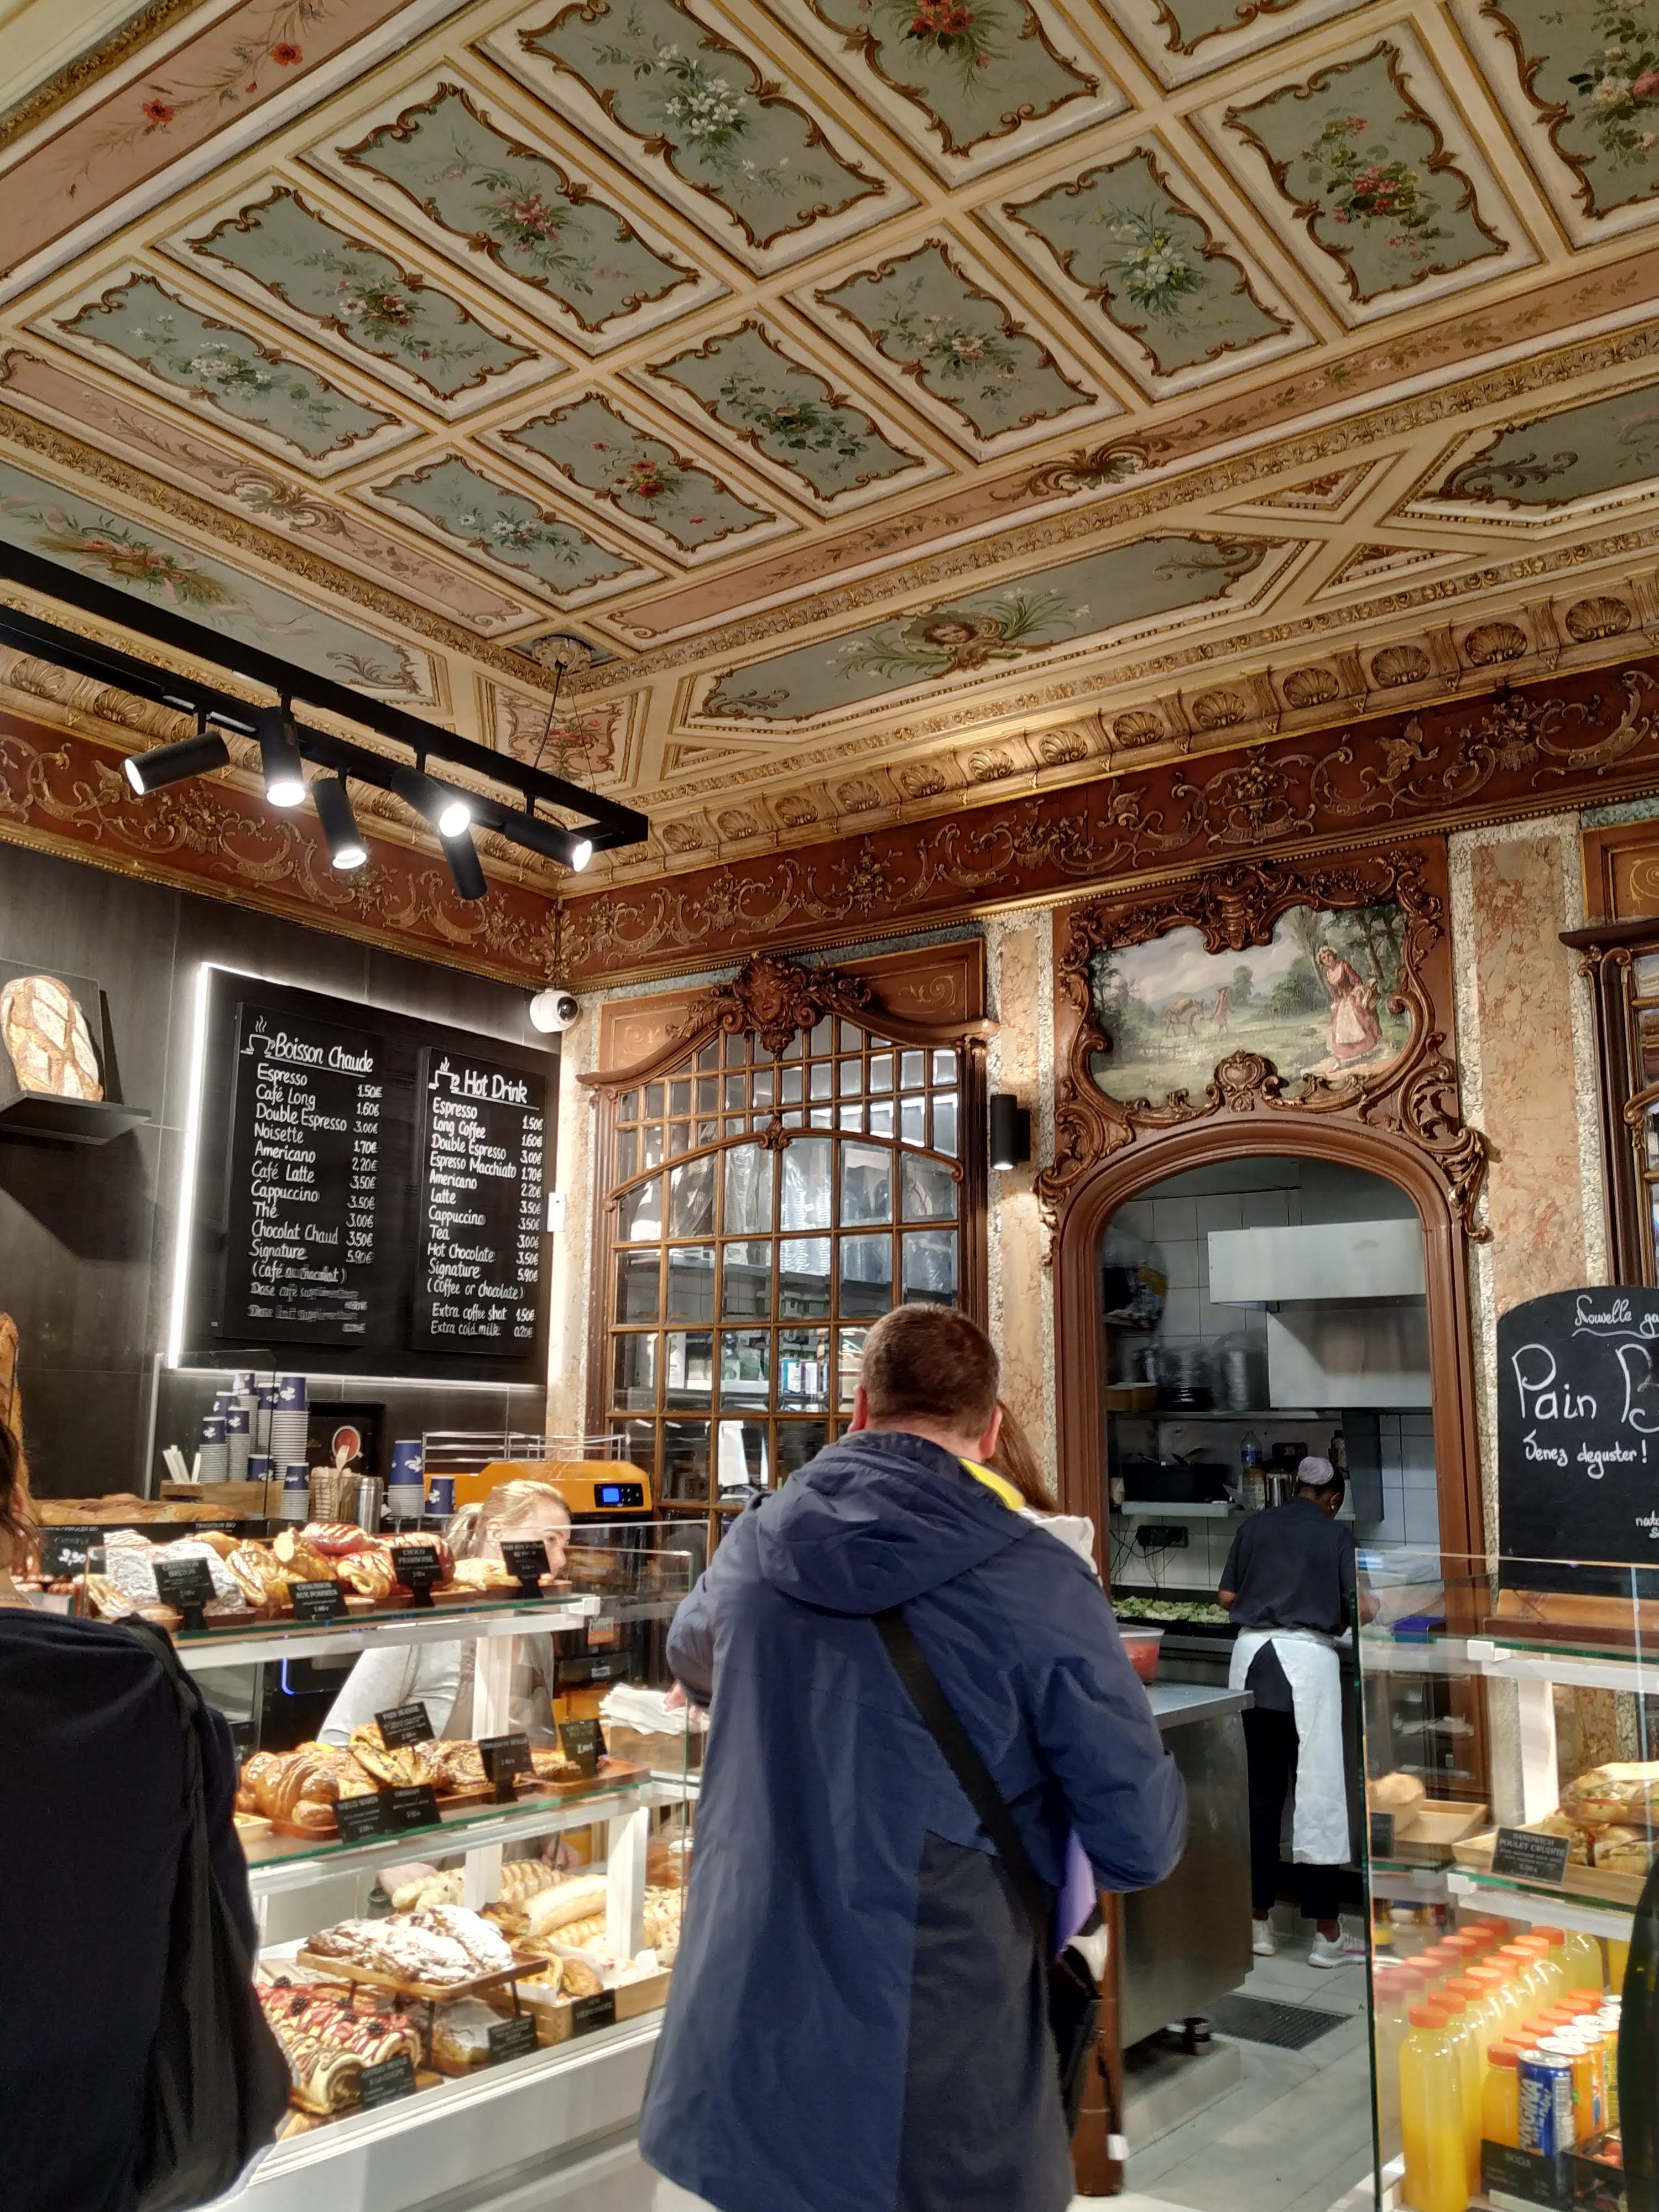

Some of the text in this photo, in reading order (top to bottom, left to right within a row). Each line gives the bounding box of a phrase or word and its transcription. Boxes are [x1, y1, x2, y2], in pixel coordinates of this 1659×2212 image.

[275, 1032, 373, 1072] Boisson Chaude
[257, 1063, 307, 1086] Espresso
[256, 1084, 284, 1105] Café
[288, 1087, 315, 1111] Long
[464, 1070, 528, 1104] Hot Drink
[256, 1103, 299, 1125] Double
[301, 1108, 347, 1131] Espresso
[432, 1097, 477, 1119] Espresso
[254, 1122, 304, 1144] Noisette
[433, 1116, 455, 1136] Long
[458, 1120, 486, 1139] Coffee
[254, 1140, 316, 1163] Americano
[431, 1133, 466, 1154] Double
[468, 1139, 507, 1161] Espresso
[251, 1161, 279, 1182] Café
[286, 1164, 315, 1183] Latte
[430, 1151, 466, 1172] Espresso
[469, 1157, 517, 1179] Macchiato
[429, 1168, 477, 1190] Americano
[251, 1180, 320, 1203] Cappuccino
[430, 1187, 457, 1204] Latte
[252, 1201, 279, 1218] Thé
[429, 1204, 487, 1227] Cappuccino
[252, 1219, 300, 1240] Chocolat
[305, 1224, 338, 1244] Chaud
[429, 1224, 451, 1241] Tea
[249, 1239, 308, 1264] Signature
[427, 1242, 447, 1258] Hot
[448, 1243, 497, 1263] Chocolate
[428, 1258, 482, 1279] Signature
[465, 1284, 476, 1296] or
[432, 1302, 460, 1318] Extra
[463, 1303, 486, 1322] coffee
[487, 1303, 508, 1321] shot
[431, 1320, 456, 1335] Extra
[458, 1322, 476, 1335] cold
[478, 1323, 501, 1337] milk
[1511, 1343, 1597, 1420] Pain
[1523, 1429, 1568, 1467] Venez
